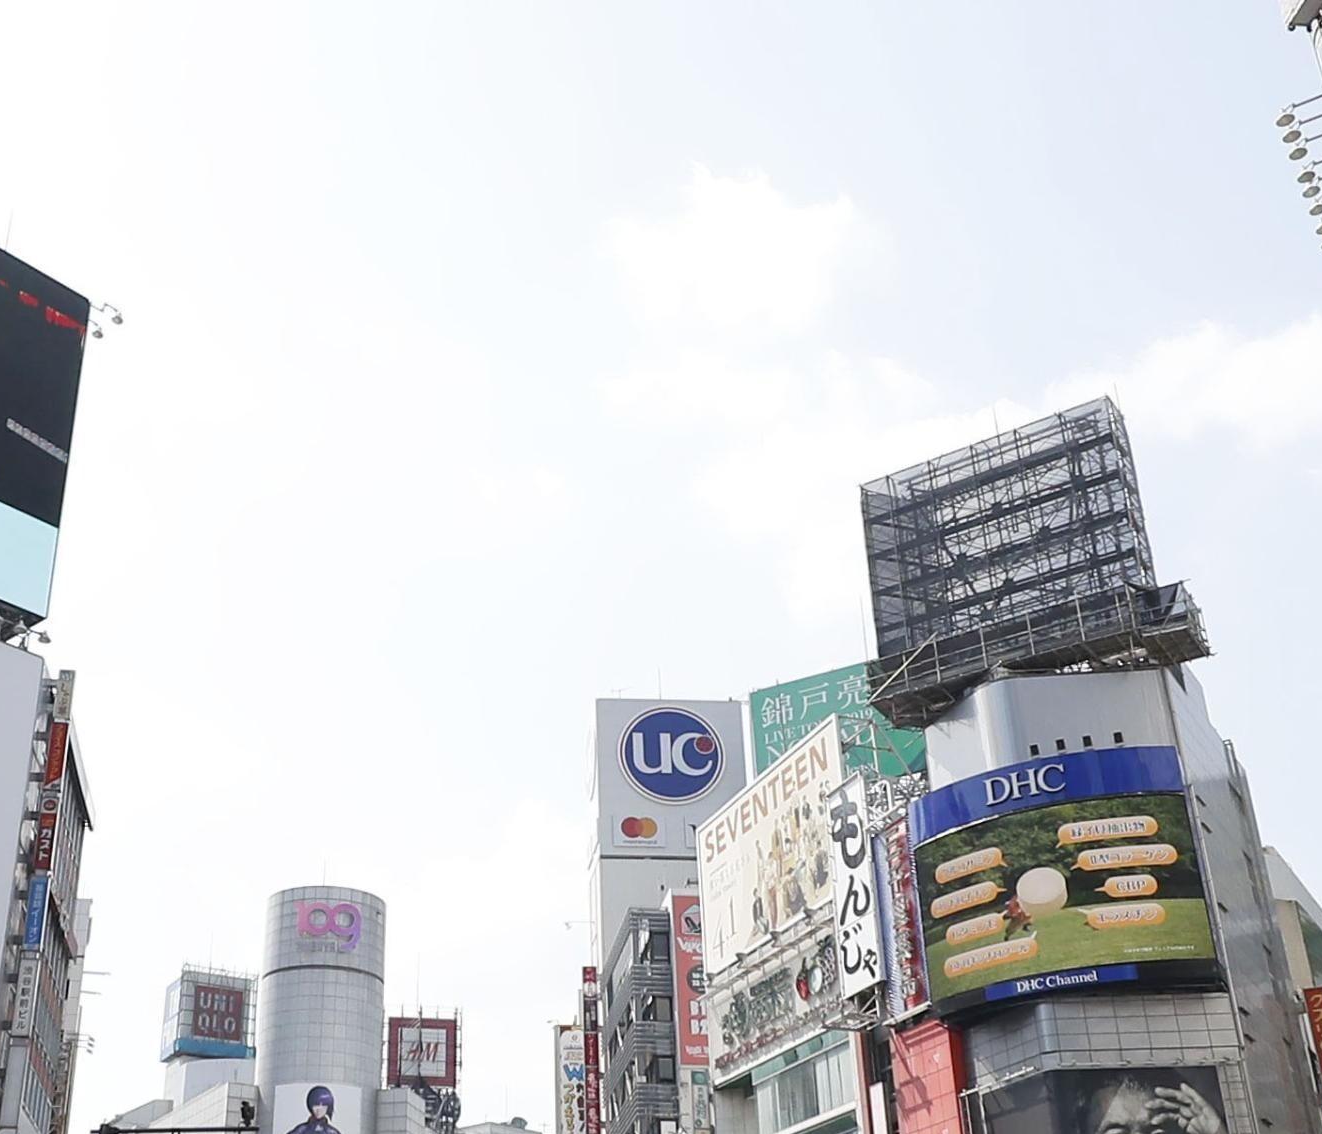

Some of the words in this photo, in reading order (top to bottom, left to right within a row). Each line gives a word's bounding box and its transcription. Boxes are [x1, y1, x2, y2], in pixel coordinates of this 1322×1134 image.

[760, 673, 868, 729] 錦戸亮
[703, 736, 830, 864] SEVENTEEN
[983, 763, 1067, 807] DHC
[831, 788, 877, 979] もんじゃ
[292, 901, 363, 949] 109
[199, 991, 235, 1013] UNI
[1015, 975, 1045, 994] DHC
[1045, 970, 1099, 989] Channel
[197, 1013, 236, 1034] QLO
